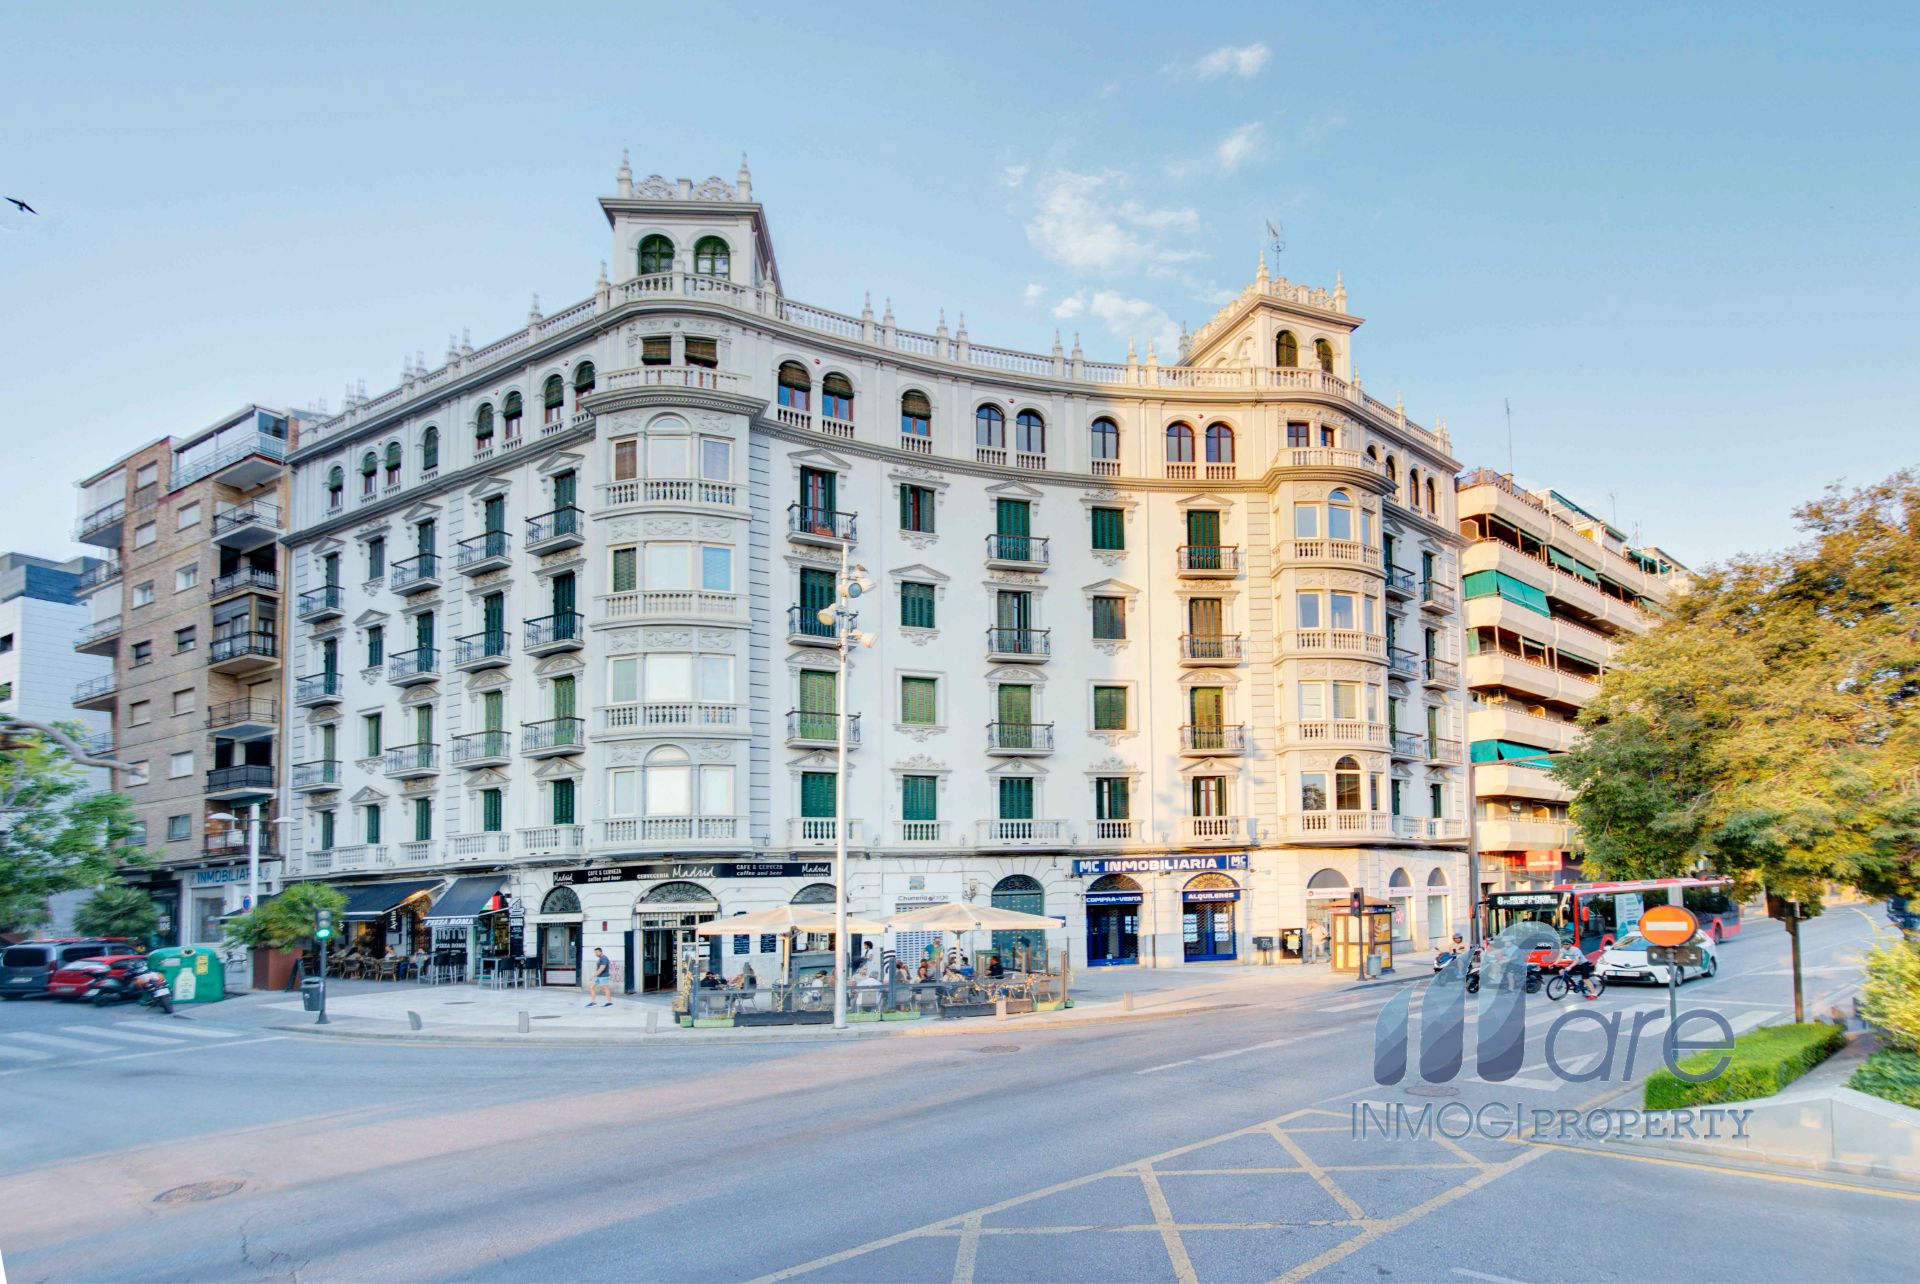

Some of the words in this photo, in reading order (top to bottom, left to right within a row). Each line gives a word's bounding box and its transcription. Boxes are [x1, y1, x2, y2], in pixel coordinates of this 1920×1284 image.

[1080, 860, 1100, 873] MC
[1104, 858, 1218, 872] INMOBILIARIA
[1231, 855, 1247, 866] MC
[672, 864, 717, 879] Madrid
[801, 862, 830, 873] Madrid
[197, 868, 263, 884] INMOBILIARA
[553, 872, 574, 883] Madrid
[1086, 895, 1142, 903] COMPRA-VENTA
[1188, 892, 1235, 900] ALQUILERES
[1497, 897, 1504, 905] 8
